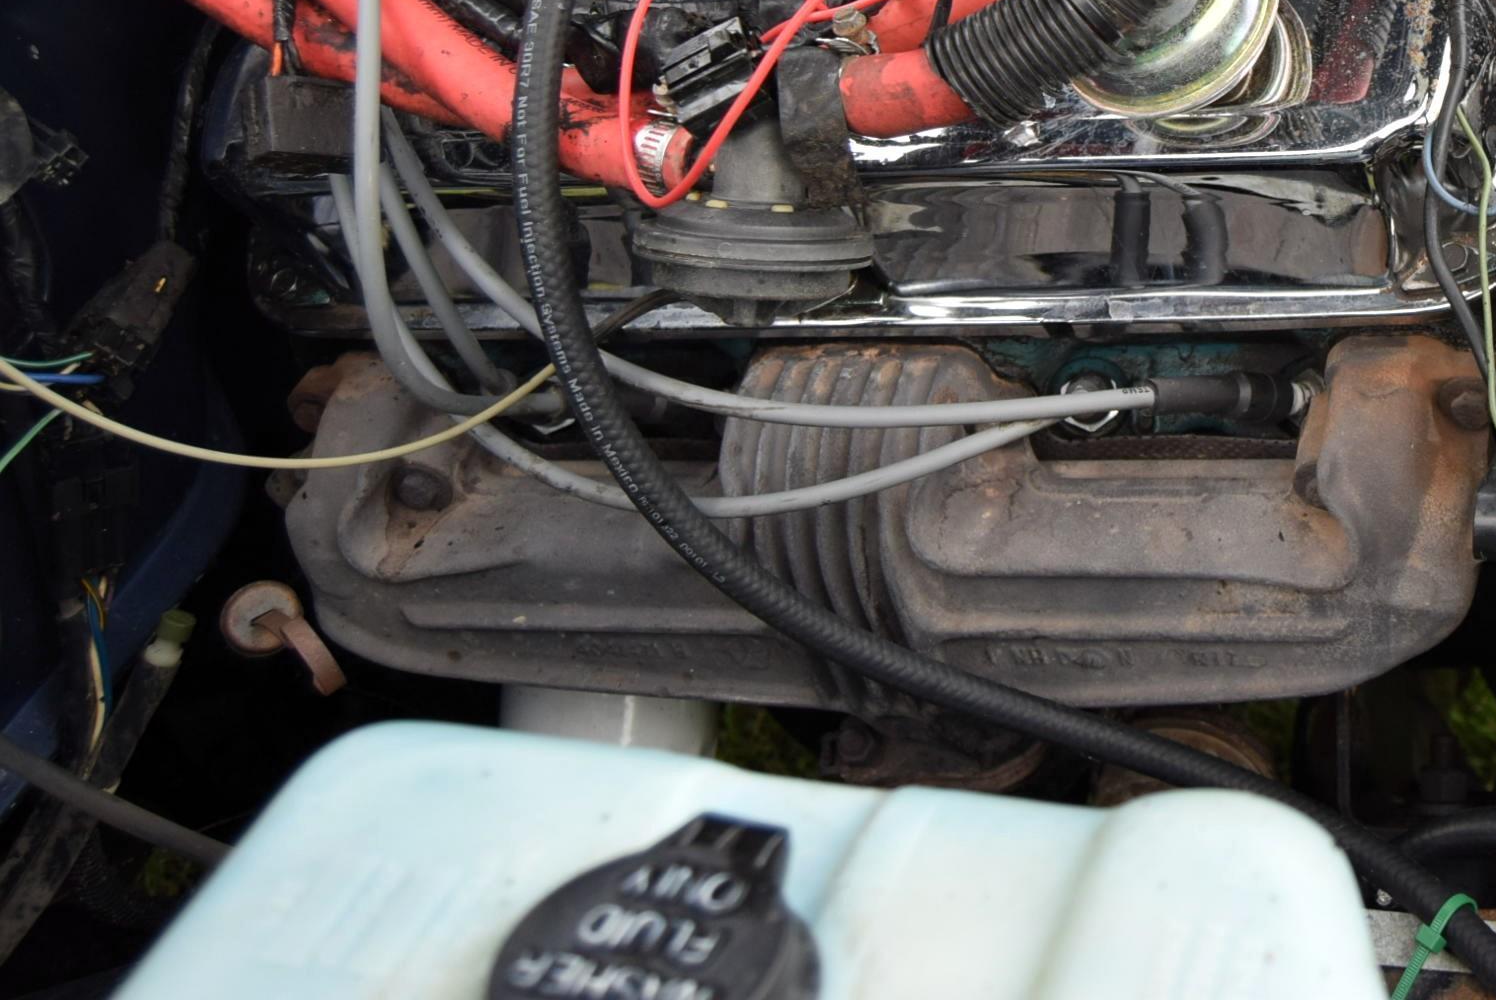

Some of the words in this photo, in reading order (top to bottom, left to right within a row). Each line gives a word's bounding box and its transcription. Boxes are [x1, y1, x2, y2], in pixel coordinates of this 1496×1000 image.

[527, 0, 542, 34] SAE
[520, 41, 534, 88] 30R7
[517, 96, 528, 127] Not
[516, 134, 527, 164] For
[517, 173, 531, 215] Fuel
[520, 221, 545, 297] Injection
[542, 303, 572, 374] Systems
[568, 378, 593, 421] Made
[591, 425, 604, 441] in
[602, 443, 639, 493] Mexico
[576, 903, 720, 964] FLUID
